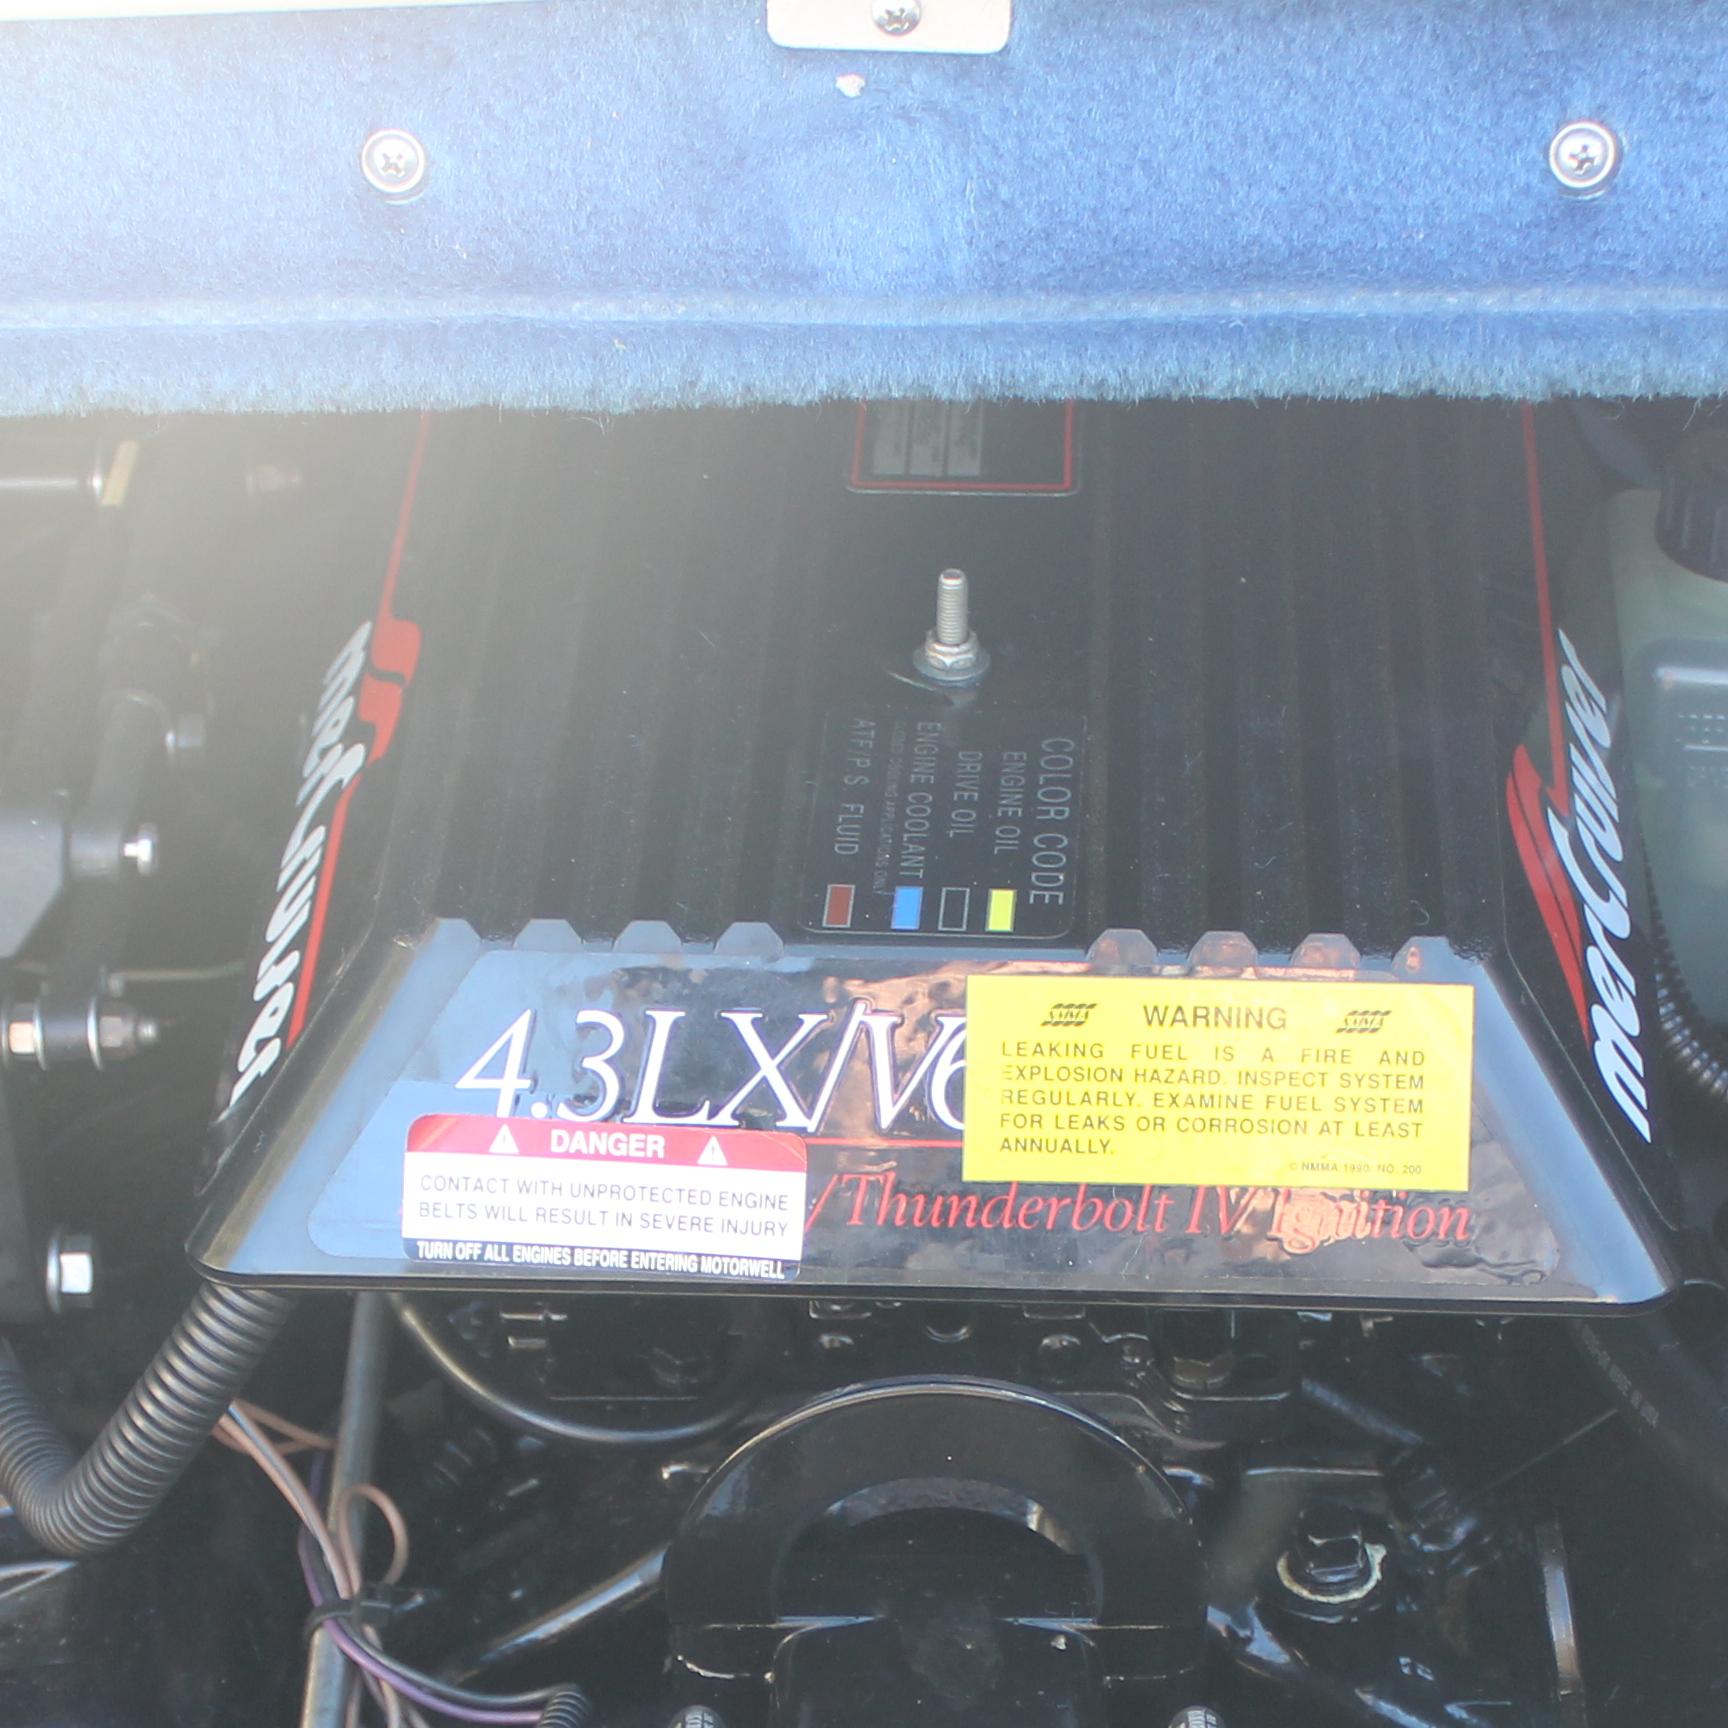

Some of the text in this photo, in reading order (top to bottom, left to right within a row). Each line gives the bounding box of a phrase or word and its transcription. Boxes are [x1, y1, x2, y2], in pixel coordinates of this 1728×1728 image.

[899, 722, 941, 879] ENGINE COOLANT
[949, 751, 982, 838] DRIVE OIL
[994, 751, 1026, 854] ENGINE OIL
[834, 804, 864, 855] FLUID
[1029, 738, 1075, 905] COLOR CODE
[1144, 1005, 1287, 1030] WARNING
[1001, 1042, 1425, 1066] LEAKING FUEL IS A FIRE AND
[1002, 1065, 1424, 1090] EXPLOSION HAZARD. INSPECT SYSTEM
[1001, 1089, 1424, 1114] REGULARLY. EXAMINE FUEL SYSTEM
[1000, 1113, 1424, 1138] FOR LEAKS OR CORROSION AT LEAST
[550, 1129, 665, 1159] DANGER
[1000, 1137, 1114, 1155] ANNUALLY.
[1302, 1161, 1339, 1173] NMMA
[1402, 1164, 1423, 1175] 200
[421, 1174, 789, 1211] CONTACT WITH UNPROTECTED ENGINE
[419, 1202, 789, 1237] BELTS WILL RESULT IN SEVERE INJURY
[1184, 1184, 1256, 1235] IV
[1268, 1187, 1473, 1252] Ignition
[417, 1240, 785, 1280] TURN OFF ALL ENGINES BEFORE ENTERING MOTORWELL
